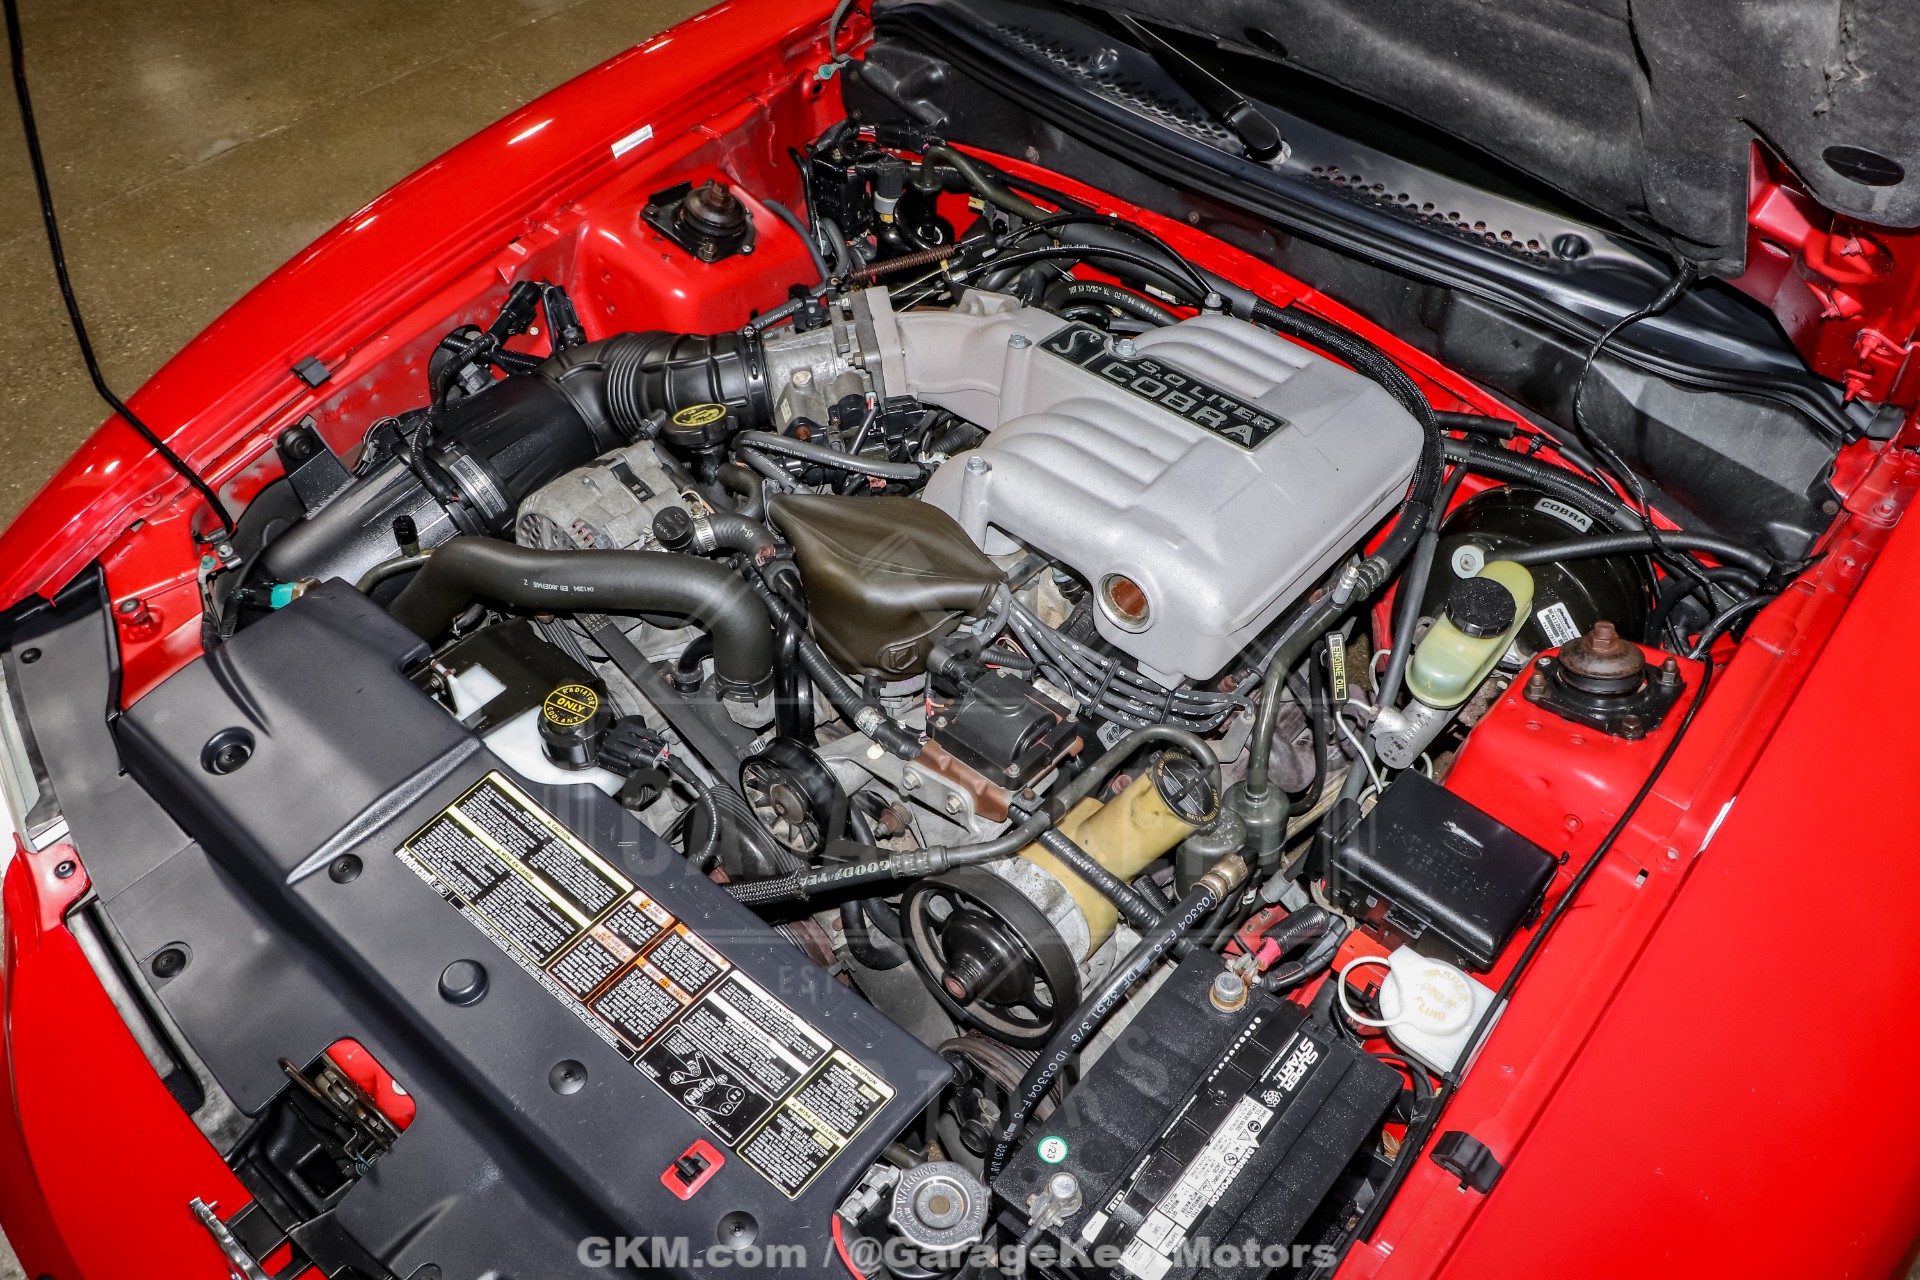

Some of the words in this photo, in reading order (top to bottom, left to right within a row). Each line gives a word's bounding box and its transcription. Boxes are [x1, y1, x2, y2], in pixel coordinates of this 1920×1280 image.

[1101, 362, 1254, 447] COBRA
[1138, 361, 1186, 387] 5.0
[1190, 387, 1275, 431] LITER
[1541, 501, 1586, 526] COBRA
[1332, 646, 1343, 676] ENGINE
[563, 687, 595, 705] RADIATOR
[1336, 679, 1344, 692] OIL
[547, 707, 579, 723] COOLANT
[557, 698, 585, 712] ONLY
[551, 823, 571, 840] CAUTION
[394, 847, 438, 885] Motorcraft
[500, 852, 512, 862] MISE
[517, 866, 534, 880] GARDE
[1175, 893, 1211, 933] 03304
[663, 940, 673, 949] AIR
[671, 947, 683, 957] BAG
[681, 955, 700, 971] SYSTEM
[666, 937, 676, 945] OR
[674, 944, 704, 968] DISCONNECT
[702, 966, 714, 976] THE
[670, 934, 680, 942] DO
[678, 940, 689, 950] NOT
[687, 948, 706, 963] TAMPER
[704, 961, 718, 973] WITH
[617, 982, 638, 1000] COUSSIN
[635, 997, 644, 1005] DE
[621, 979, 631, 987] DU
[629, 985, 656, 1008] DISPOSITIF
[654, 1007, 668, 1019] D'UN
[633, 968, 642, 977] NE
[641, 975, 652, 985] PAS
[650, 983, 679, 1008] MANIPULER
[1090, 987, 1121, 1021] 3251
[765, 997, 794, 1022] ATTENTION
[1413, 996, 1446, 1021] FLUID
[852, 1064, 877, 1085] CAUTION
[1274, 1037, 1315, 1085] START
[1282, 1049, 1318, 1091] SUPER
[1024, 1060, 1061, 1101] 03304
[797, 1106, 812, 1119] MISE
[811, 1118, 821, 1126] EN
[819, 1124, 840, 1142] GARDE
[1047, 1141, 1058, 1159] 1/23
[897, 1163, 938, 1204] WARNING
[1207, 1145, 1255, 1208] DANGER/POISON
